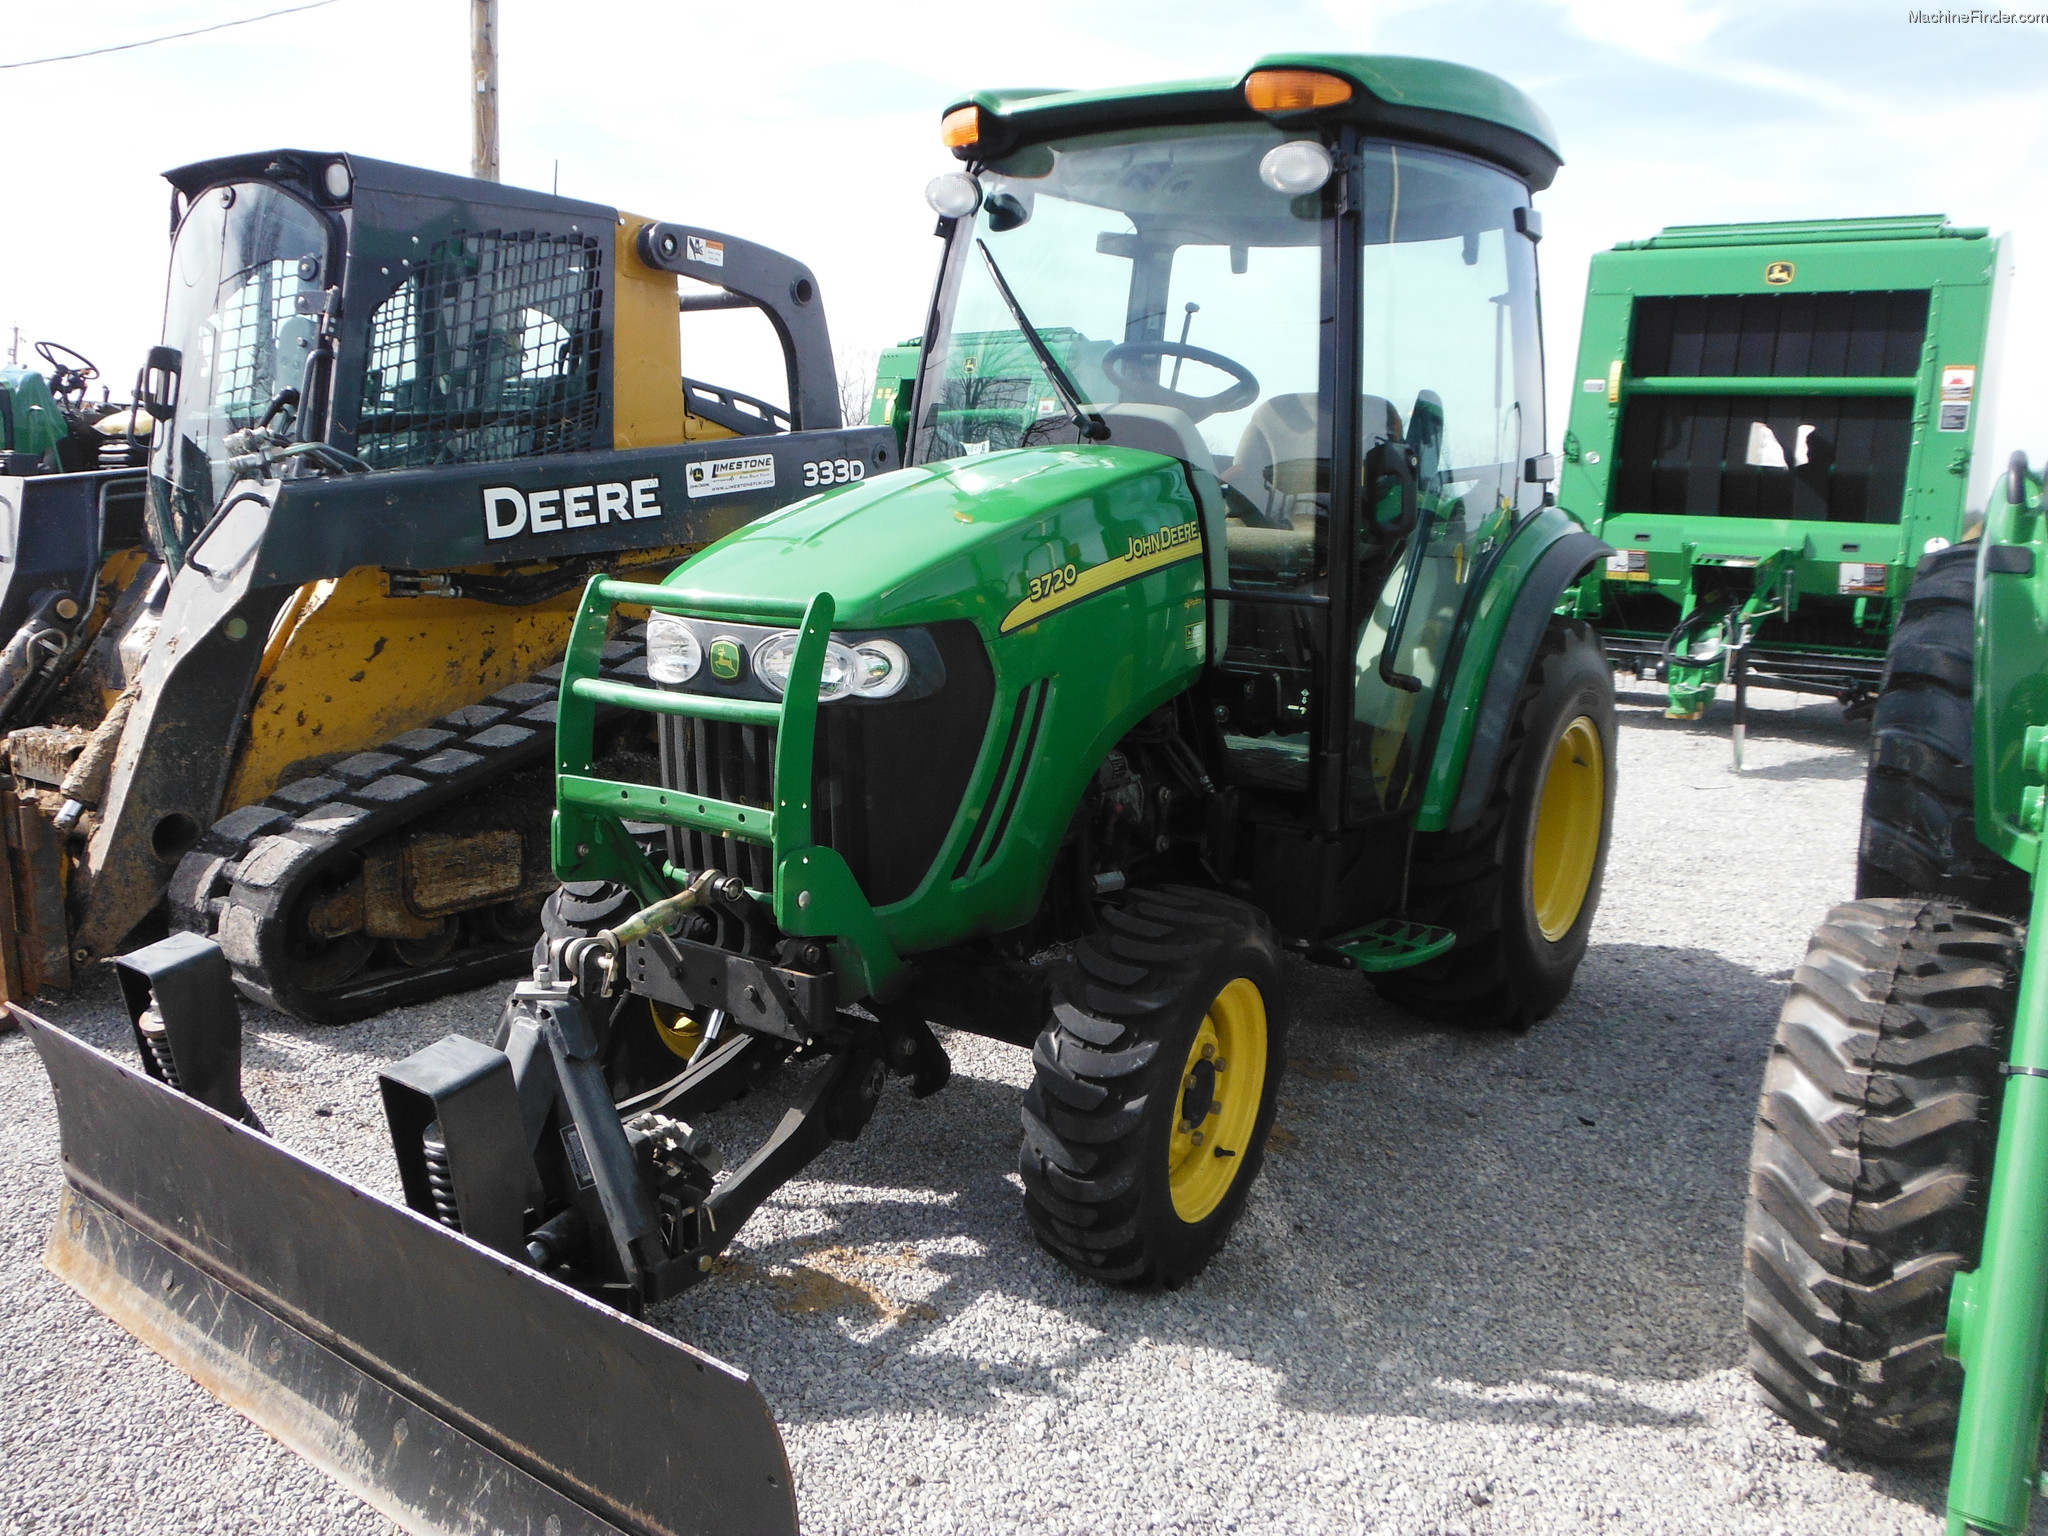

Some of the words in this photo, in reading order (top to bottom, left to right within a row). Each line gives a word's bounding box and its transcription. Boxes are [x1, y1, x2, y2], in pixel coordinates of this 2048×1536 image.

[712, 457, 772, 478] LIMESTONE
[803, 459, 865, 487] 333D
[483, 477, 662, 540] DEERE
[1124, 533, 1160, 562] JOHN
[1159, 520, 1199, 548] DEERE
[1029, 563, 1077, 602] 3720
